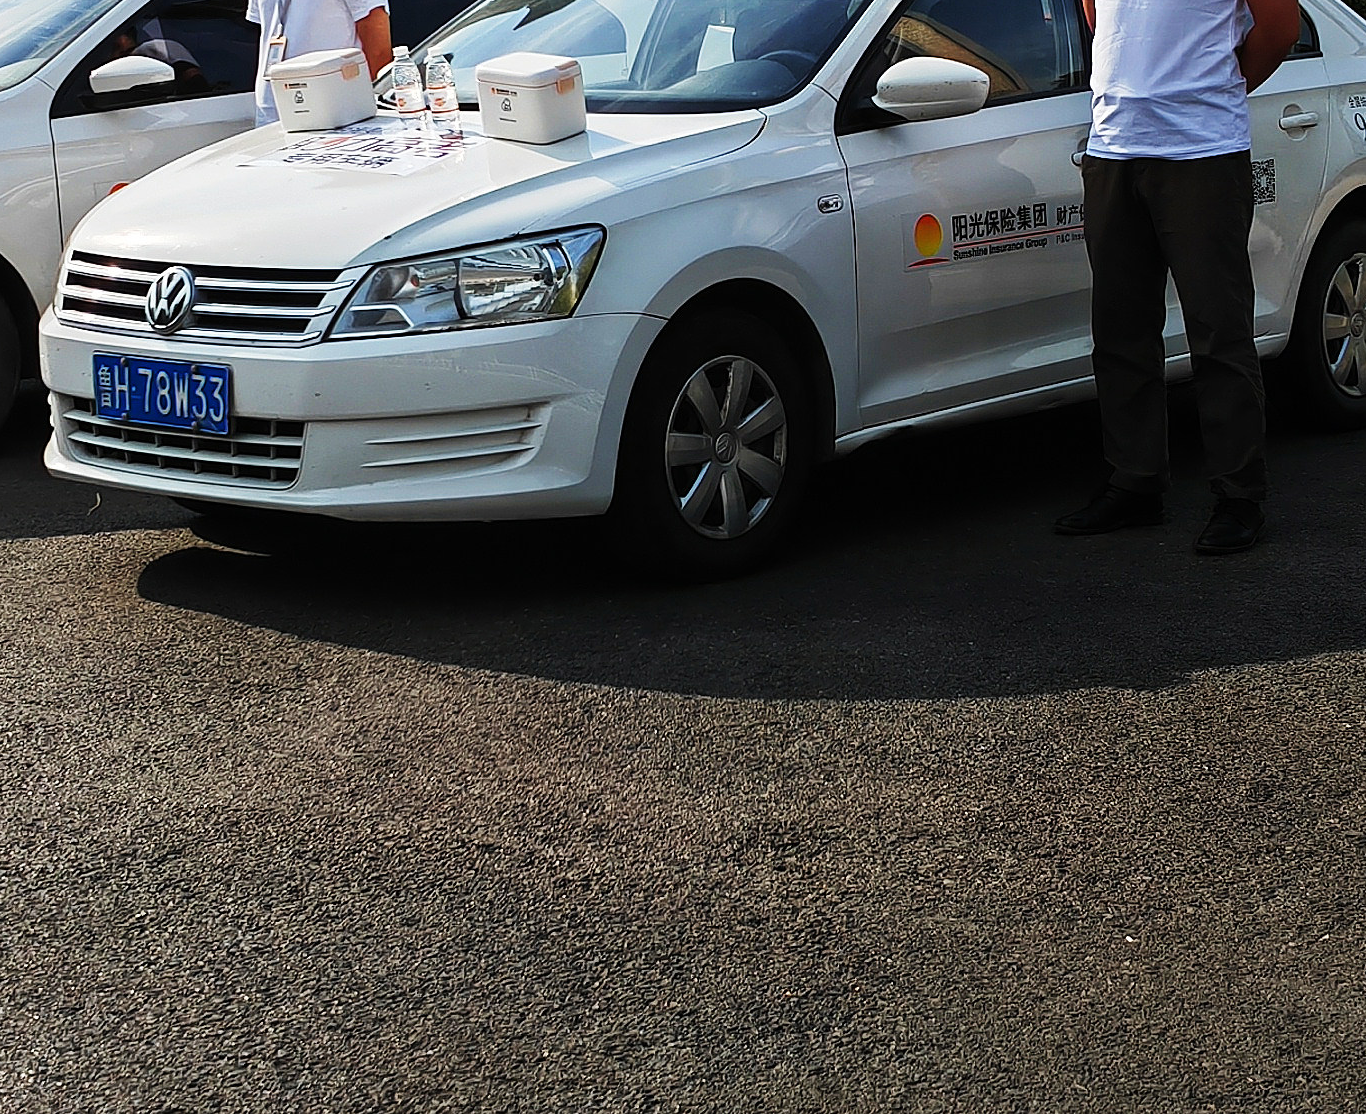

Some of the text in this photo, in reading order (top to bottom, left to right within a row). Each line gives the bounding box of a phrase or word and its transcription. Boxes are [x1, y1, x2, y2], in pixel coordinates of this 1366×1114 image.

[951, 202, 1048, 242] 阳光保险集团
[953, 246, 988, 261] Sunshine
[989, 241, 1025, 256] Insurance
[1025, 237, 1048, 249] Group
